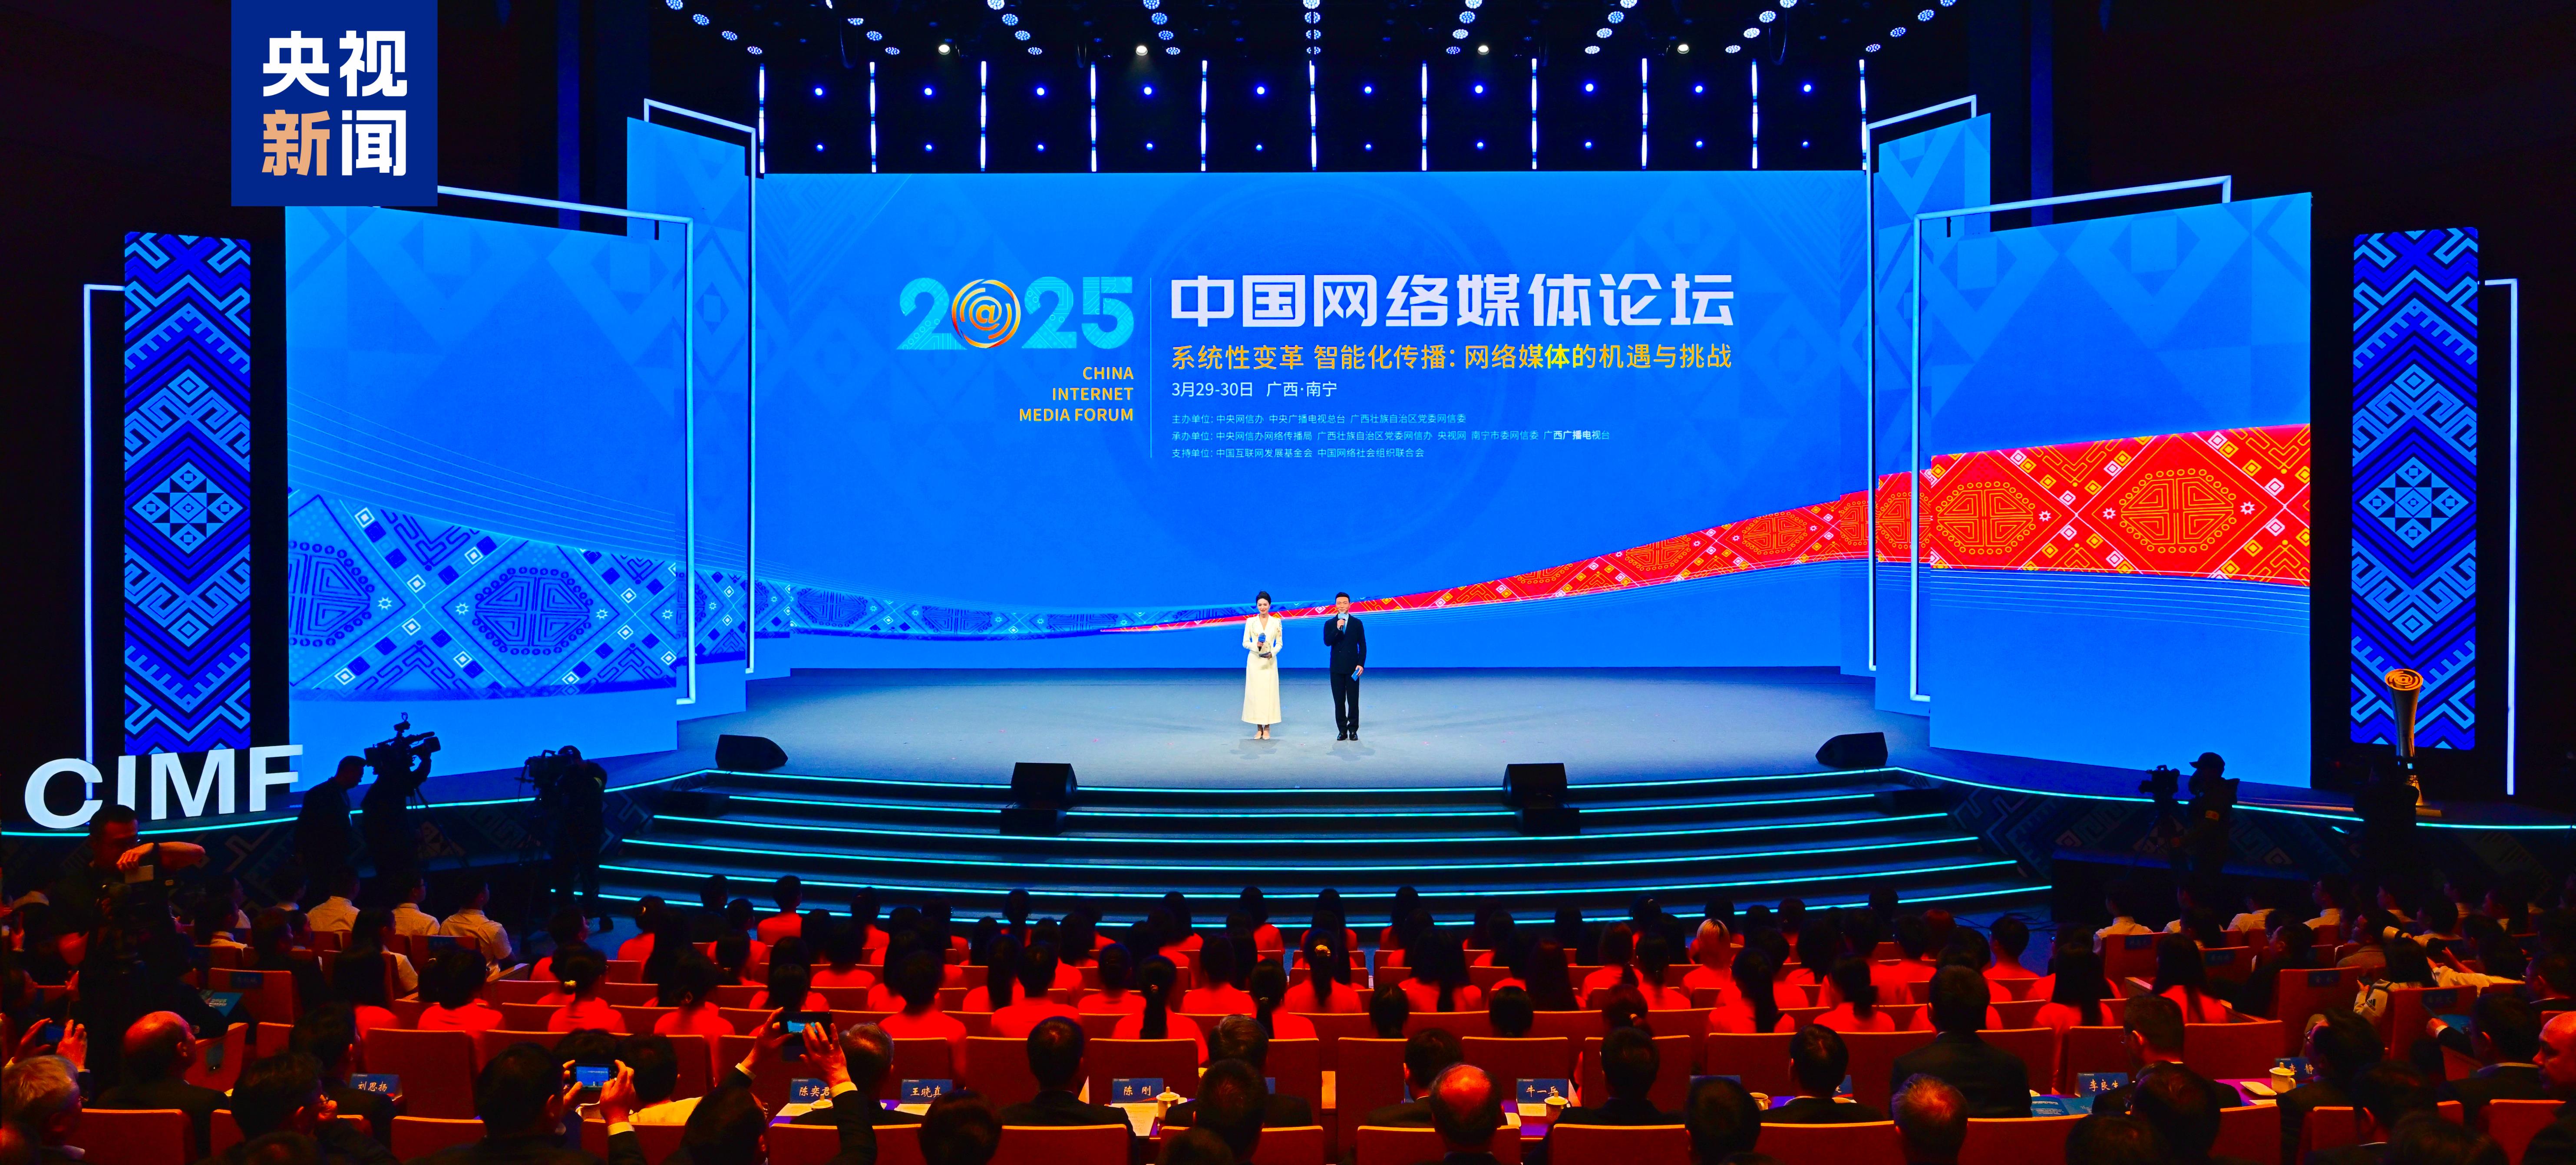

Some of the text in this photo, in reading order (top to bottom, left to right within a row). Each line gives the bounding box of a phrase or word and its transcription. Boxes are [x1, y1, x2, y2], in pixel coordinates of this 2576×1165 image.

[1171, 273, 1734, 327] 中国网络媒体论坛
[1172, 344, 1304, 370] 系统性变革
[1083, 366, 1134, 380] CHINA
[1052, 387, 1134, 401] INTERNET
[1171, 380, 1338, 397] 3月29-30日 广西·南宁
[1019, 408, 1133, 422] MEDIA FORUM
[1269, 414, 1345, 424] 中央广播电视总台
[1350, 413, 1466, 424] 广西壮族自治区党委网信委
[1317, 431, 1433, 441] 广西壮族自治区党委网信办
[1437, 431, 1466, 440] 央视网
[1471, 430, 1539, 440] 南宁市委网信委
[1543, 429, 1610, 440] 广西广播电视台
[1318, 448, 1424, 458] 中国网络社会组织联合会
[24, 744, 303, 829] CIMF
